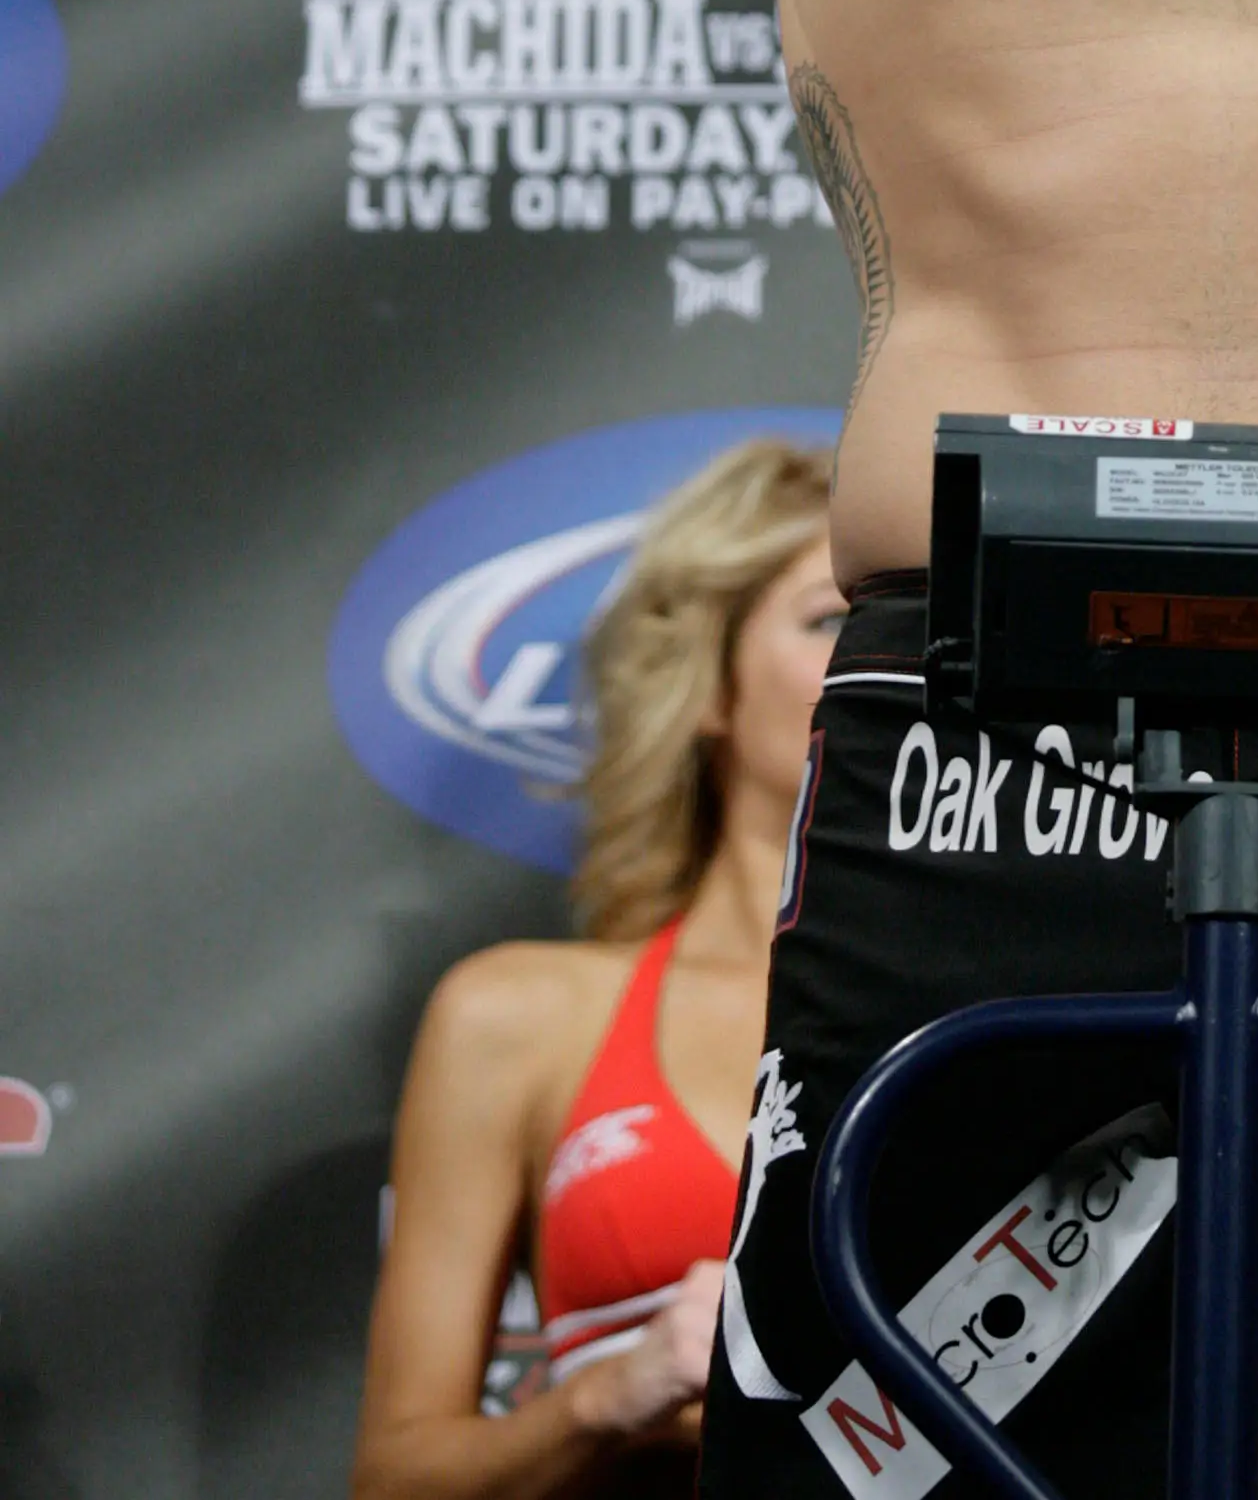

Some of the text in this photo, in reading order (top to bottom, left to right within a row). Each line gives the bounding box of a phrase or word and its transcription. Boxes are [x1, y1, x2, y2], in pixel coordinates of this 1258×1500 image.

[346, 177, 490, 231] LIVE
[511, 175, 610, 230] ON
[1026, 417, 1143, 436] SCALE
[888, 720, 1014, 854] Oak
